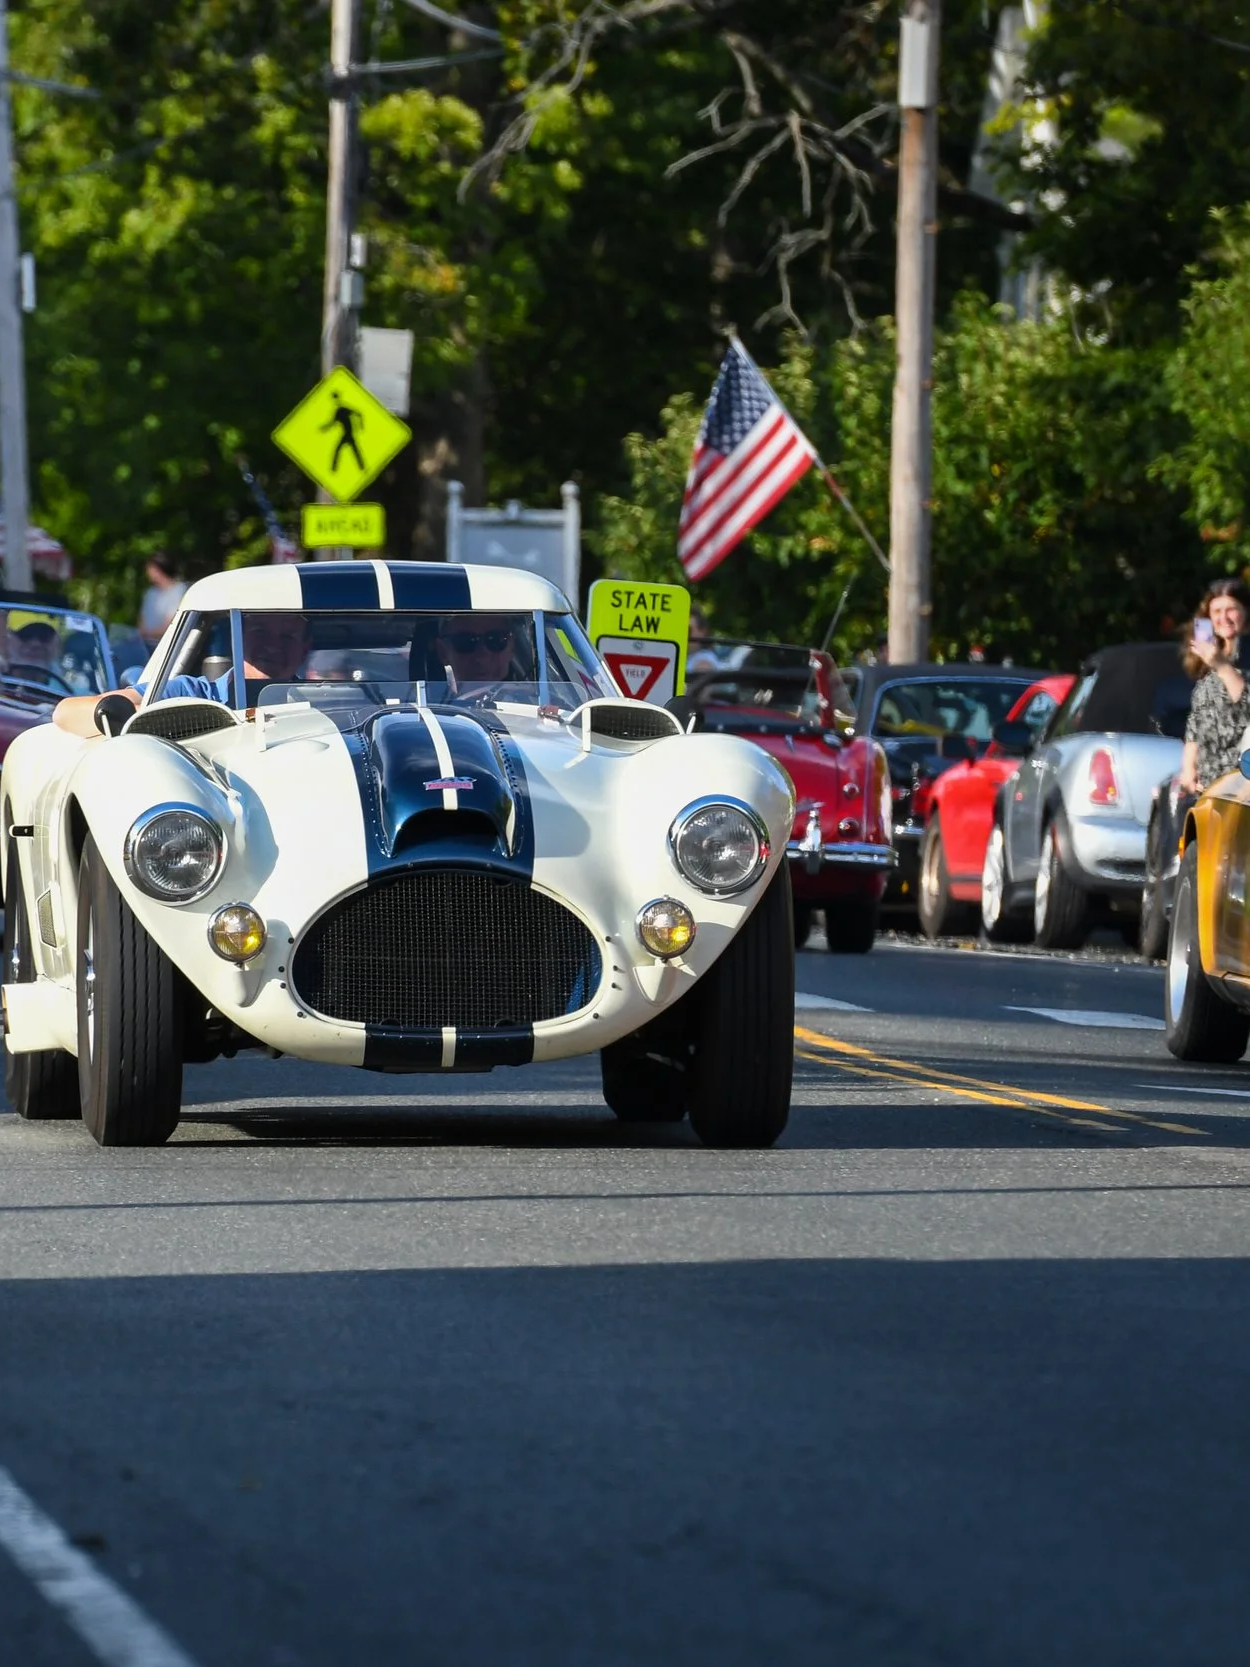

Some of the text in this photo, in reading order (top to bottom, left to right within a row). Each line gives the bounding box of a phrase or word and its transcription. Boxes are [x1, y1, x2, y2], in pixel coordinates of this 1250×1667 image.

[611, 590, 672, 612] STATE
[619, 614, 660, 634] LAW
[625, 668, 646, 678] YIELD
